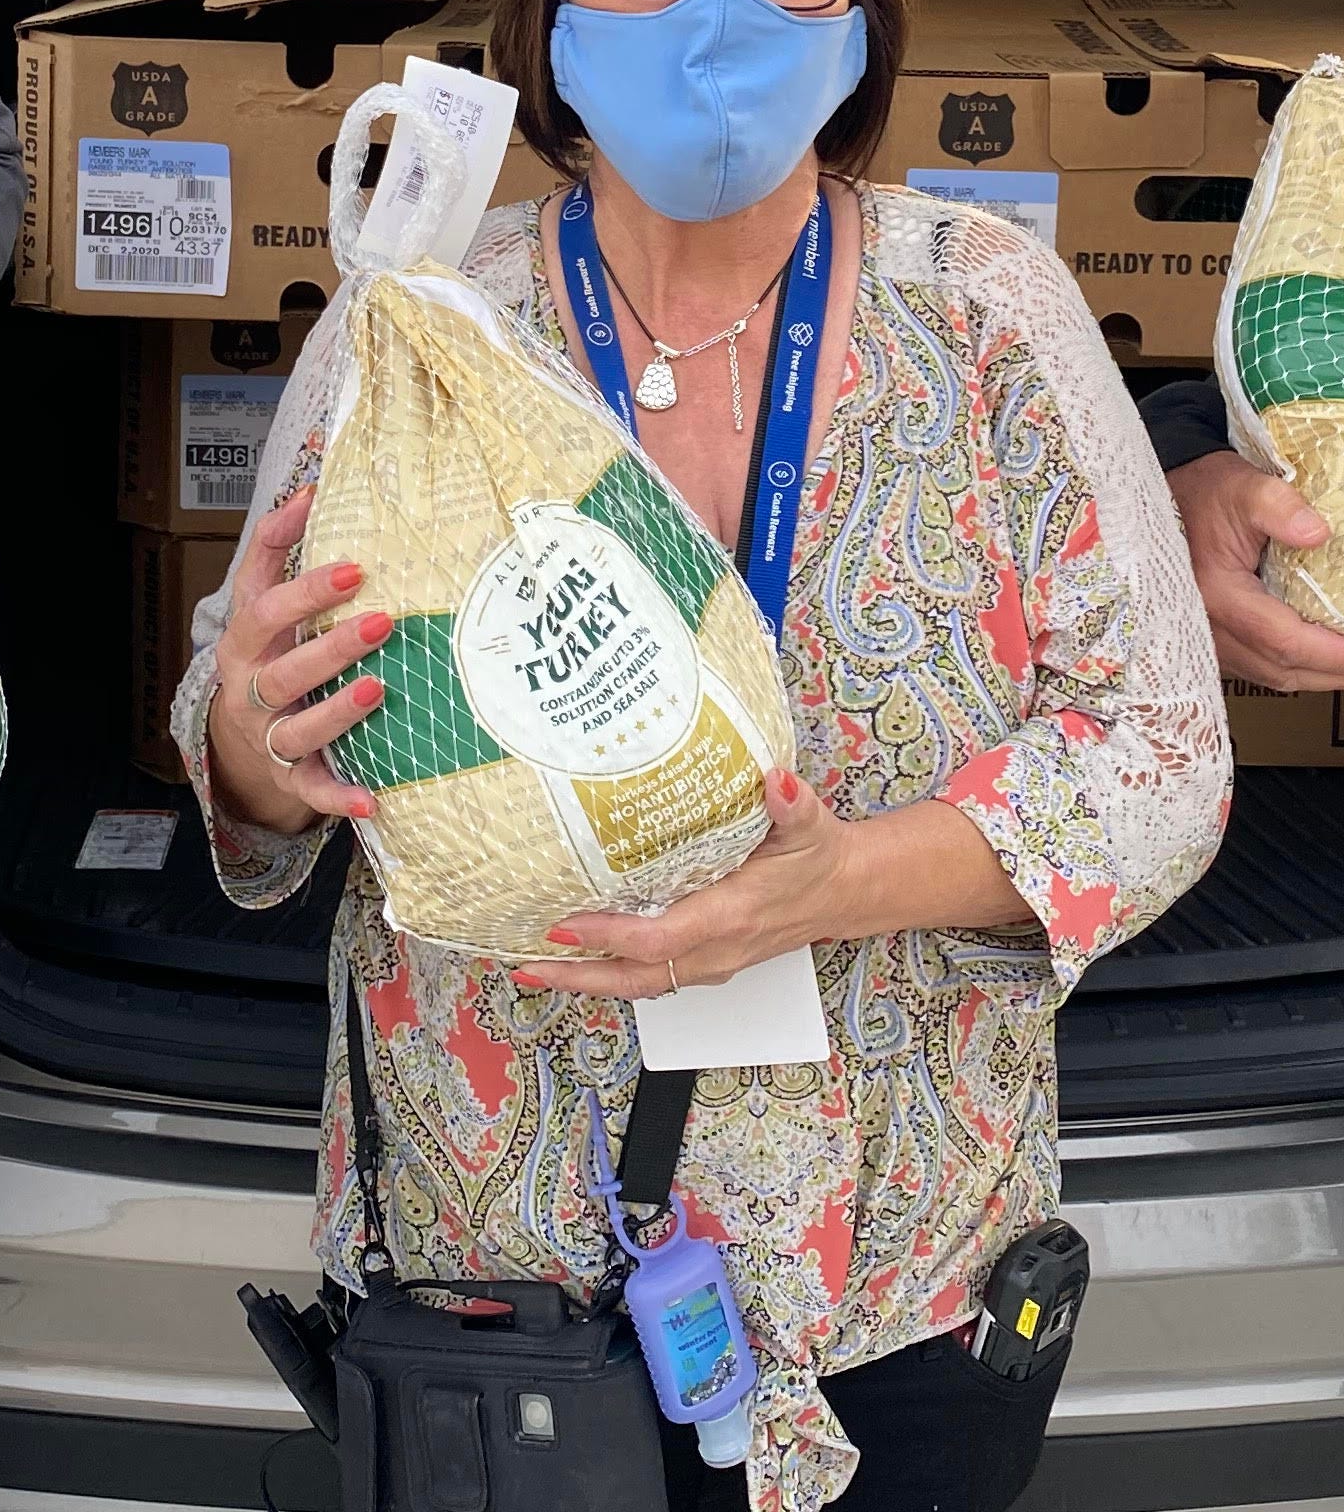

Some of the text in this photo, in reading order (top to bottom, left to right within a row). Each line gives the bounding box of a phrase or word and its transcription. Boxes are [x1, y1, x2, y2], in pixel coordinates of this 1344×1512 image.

[131, 71, 172, 82] USDA
[140, 86, 159, 106] A
[24, 57, 39, 168] PRODUCT
[125, 111, 177, 123] GRADE
[959, 102, 999, 112] USDA
[968, 116, 986, 136] A
[88, 145, 152, 159] MEMBERS MARK
[952, 141, 1002, 152] GRADE
[117, 159, 144, 167] TURKEY
[162, 160, 196, 168] SOLUTION
[954, 187, 976, 198] MARK
[87, 213, 151, 236] 1496
[184, 225, 227, 234] 203170
[22, 211, 37, 276] U.S.A.
[253, 224, 330, 248] READY
[88, 245, 110, 254] DEC
[175, 241, 222, 256] 43.37
[802, 214, 821, 280] member!
[1076, 252, 1154, 275] READY
[1162, 254, 1192, 275] TO
[586, 296, 600, 318] Cash
[782, 349, 803, 413] Free shipping
[190, 447, 247, 465] 1496
[191, 474, 210, 482] DEC
[764, 492, 783, 562] Cash Rewards
[514, 581, 632, 693] TURKEY
[539, 661, 614, 713] CONTAINING
[550, 685, 615, 727] SOLUTION
[582, 669, 661, 734] AND SEA SALT
[610, 777, 658, 804] Turkeys
[657, 749, 695, 781] Raised
[638, 770, 724, 829] HORMONES
[609, 804, 635, 825] NO
[606, 838, 632, 855] OR
[695, 1336, 718, 1354] scent
